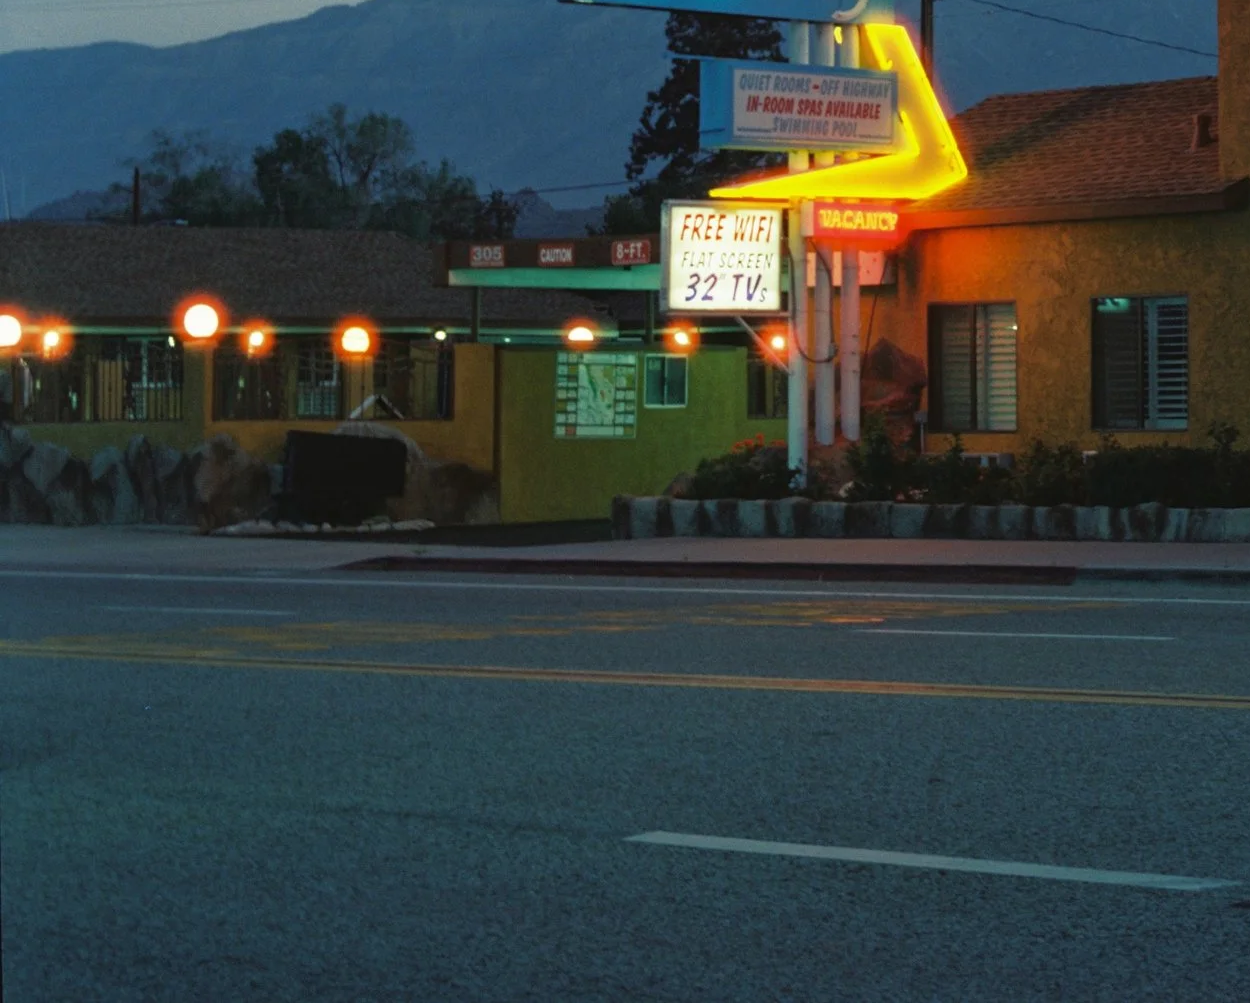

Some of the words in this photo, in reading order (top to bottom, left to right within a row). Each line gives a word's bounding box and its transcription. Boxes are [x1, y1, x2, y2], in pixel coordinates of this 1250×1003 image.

[739, 73, 771, 91] QUIET
[773, 75, 811, 94] ROOMS
[820, 79, 839, 95] OFF
[842, 81, 890, 98] HIGHWAY
[746, 95, 794, 114] IN-ROOM
[797, 100, 823, 116] SPAS
[825, 101, 881, 120] AVAILABLE
[680, 214, 726, 241] FREE
[733, 215, 774, 243] WIFI
[818, 209, 898, 231] VACANCY
[472, 247, 502, 261] 305
[540, 248, 573, 263] CAUTION
[681, 251, 714, 268] FLAT
[719, 252, 774, 269] SCREEN
